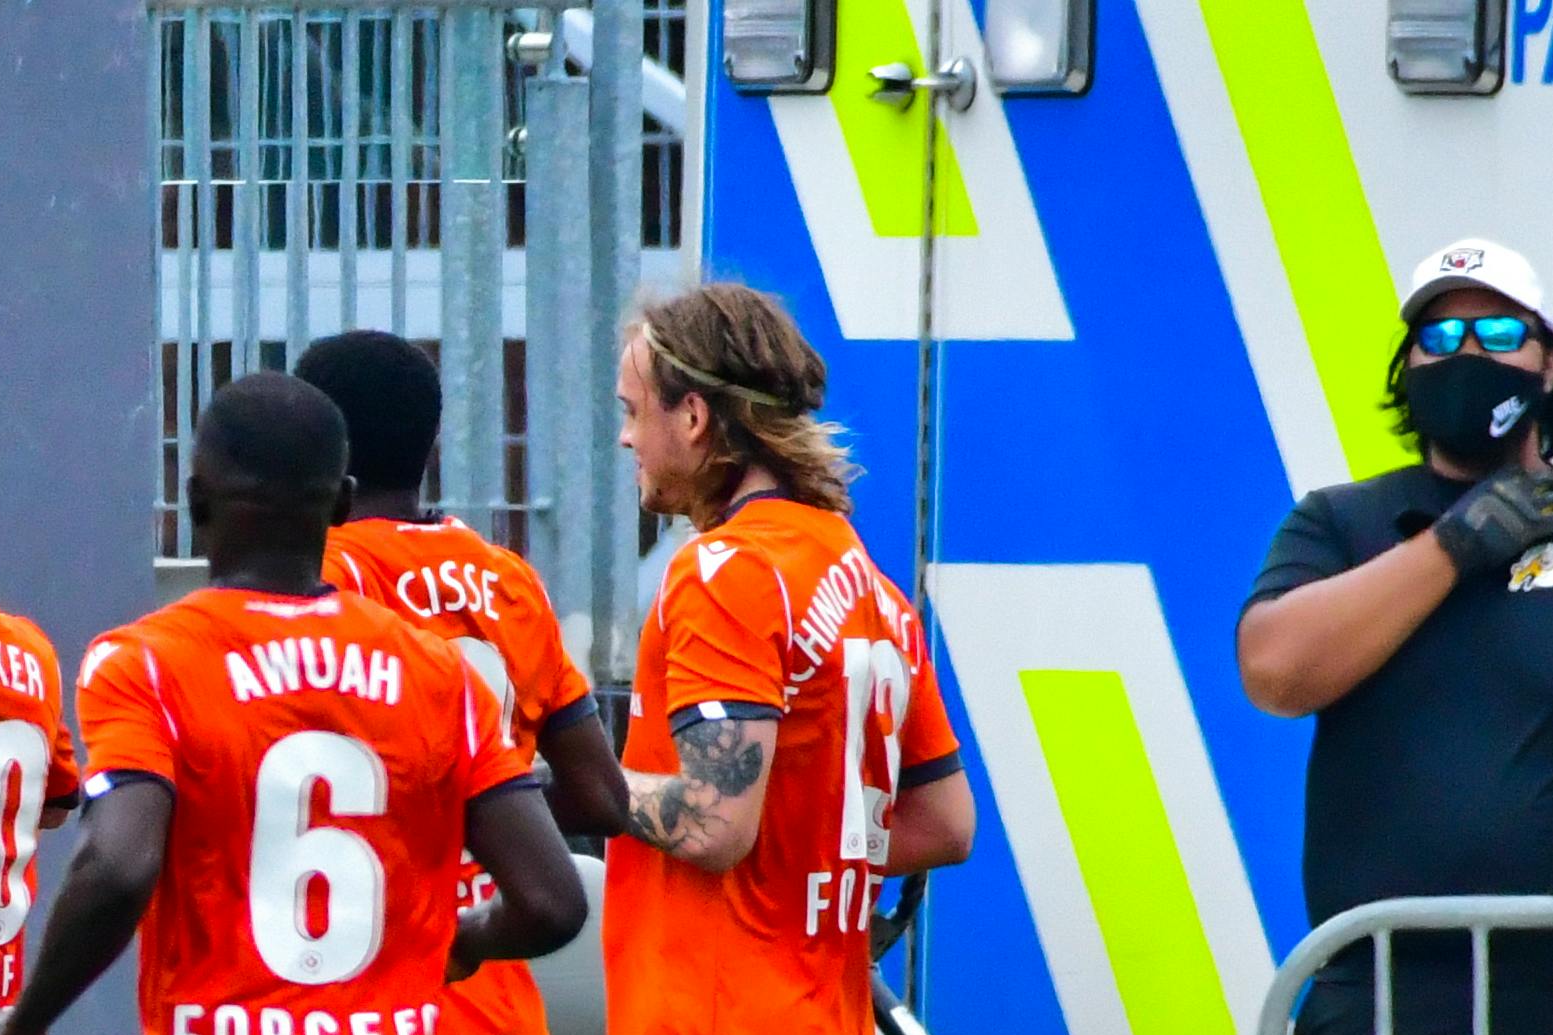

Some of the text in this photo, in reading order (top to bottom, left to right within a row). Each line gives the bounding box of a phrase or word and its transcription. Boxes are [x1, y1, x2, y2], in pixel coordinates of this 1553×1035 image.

[1511, 0, 1553, 85] P
[397, 560, 499, 620] CISSE
[225, 637, 401, 705] AWUAH
[250, 730, 388, 985] 6
